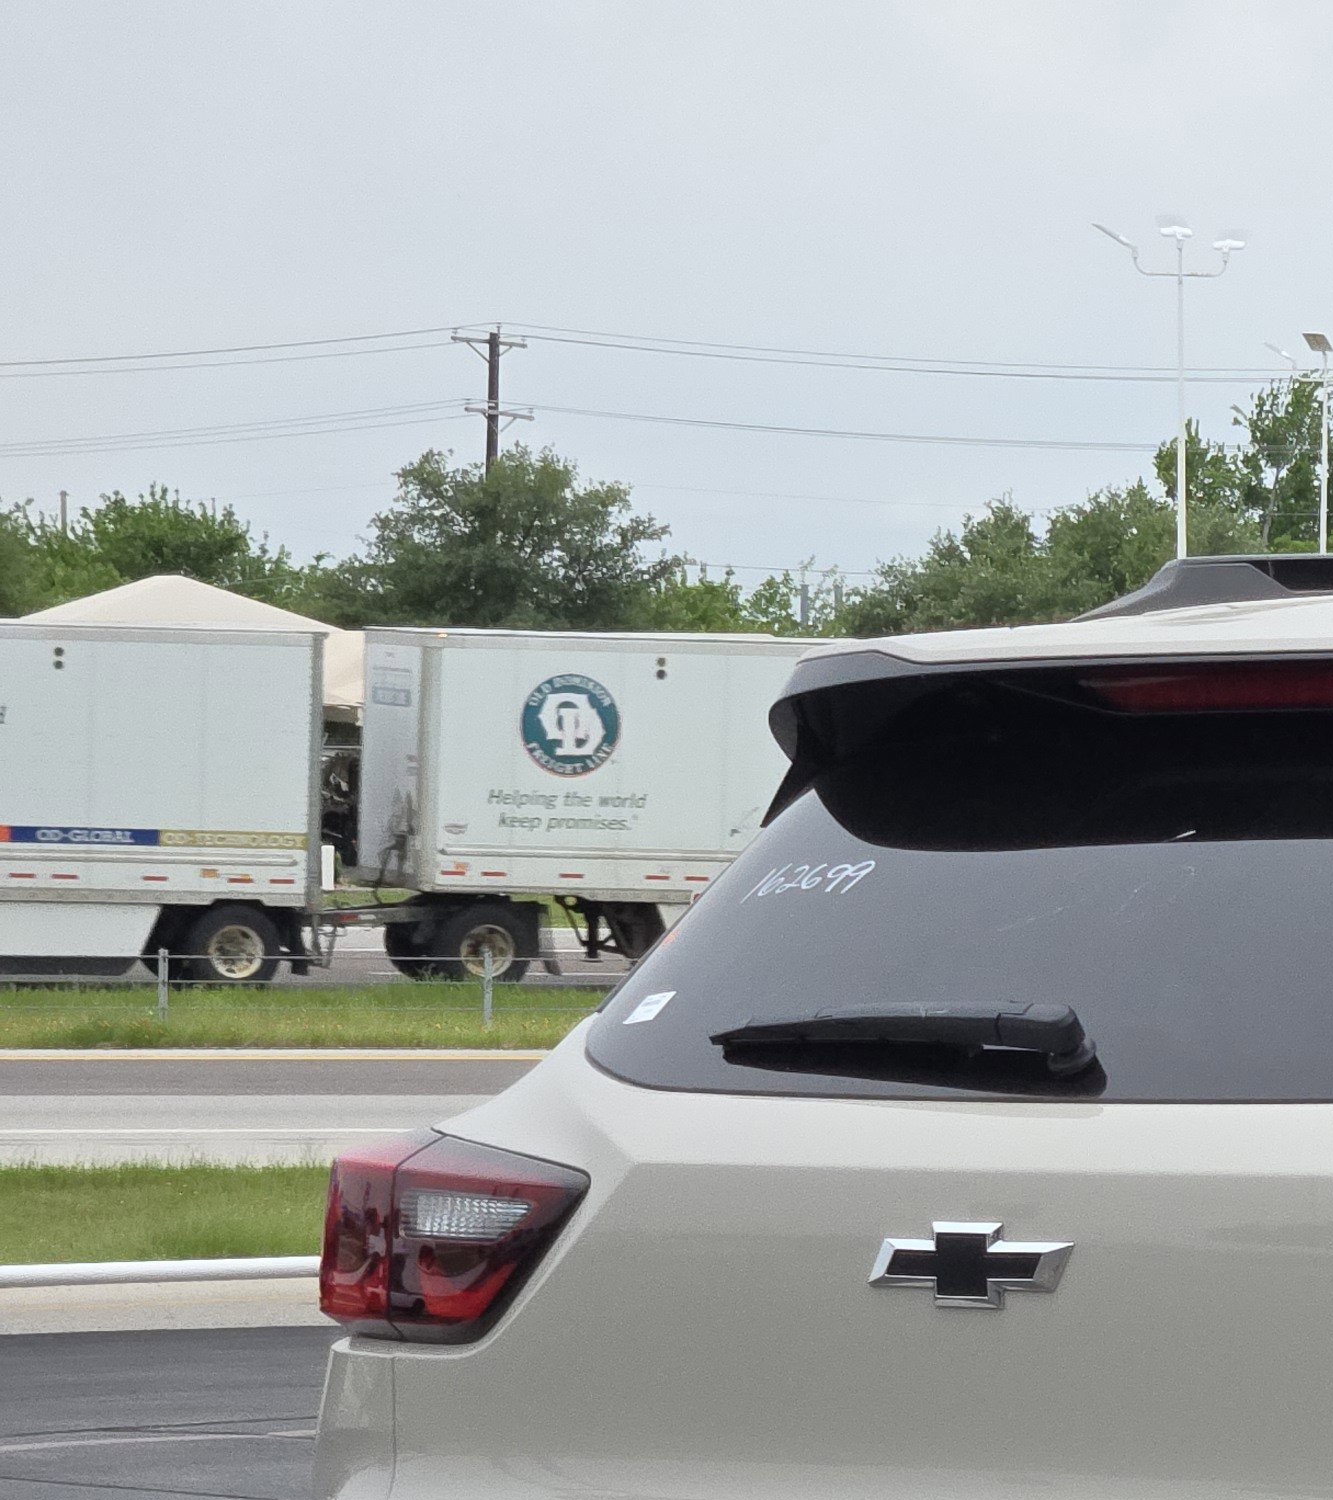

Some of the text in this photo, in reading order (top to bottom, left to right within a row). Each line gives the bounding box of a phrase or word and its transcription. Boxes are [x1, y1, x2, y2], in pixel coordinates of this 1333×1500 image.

[487, 789, 649, 809] Helping the world
[498, 812, 543, 832] keep
[34, 828, 136, 843] OD-GLOBAL
[741, 860, 876, 903] 162699
